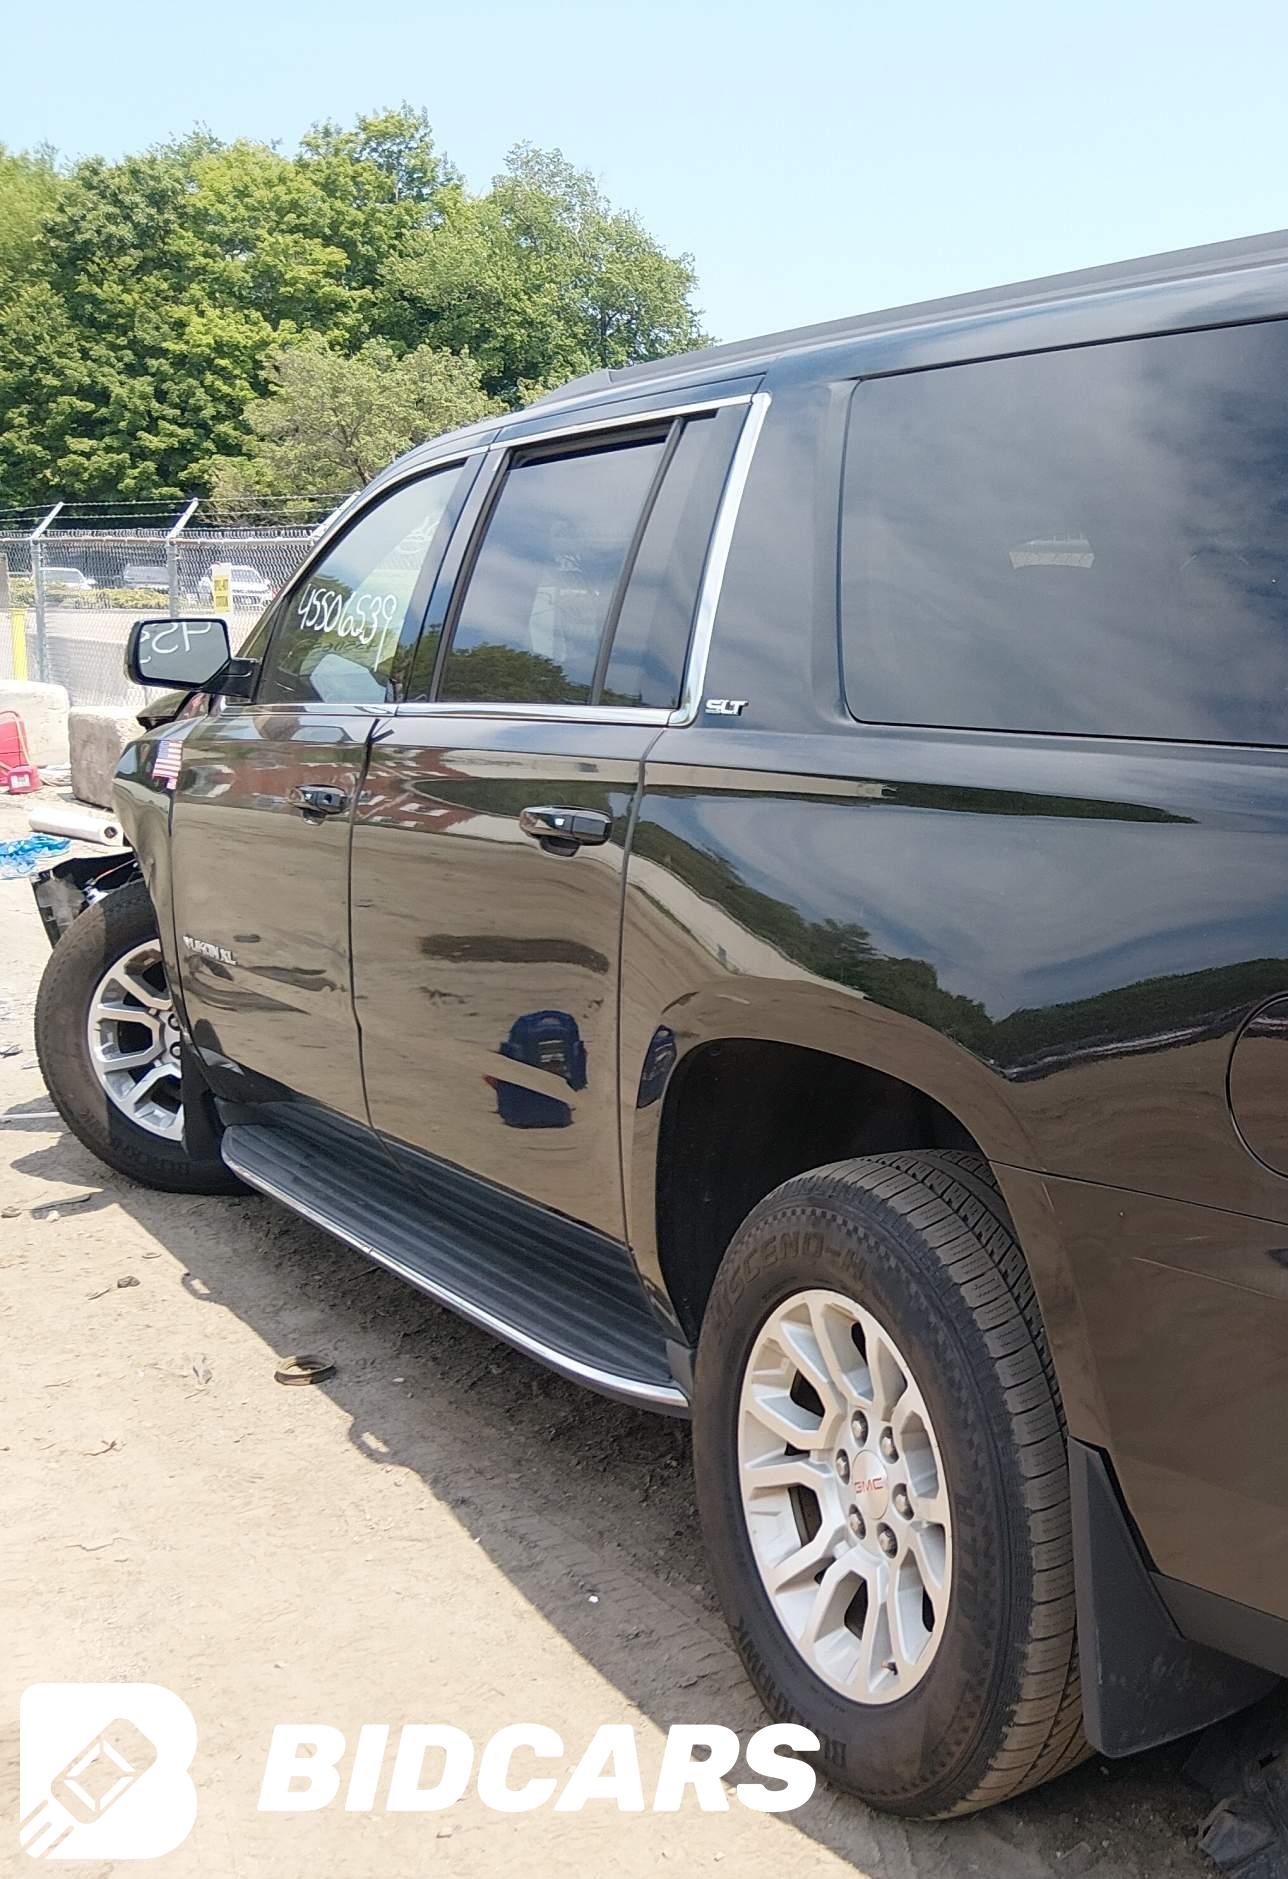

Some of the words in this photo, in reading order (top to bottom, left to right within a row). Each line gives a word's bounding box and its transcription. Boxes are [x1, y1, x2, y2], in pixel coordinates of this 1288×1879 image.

[297, 583, 397, 672] 45506539
[704, 698, 749, 716] SLT
[183, 935, 220, 961] YUKON
[220, 948, 238, 966] XL
[854, 1477, 884, 1494] GMC
